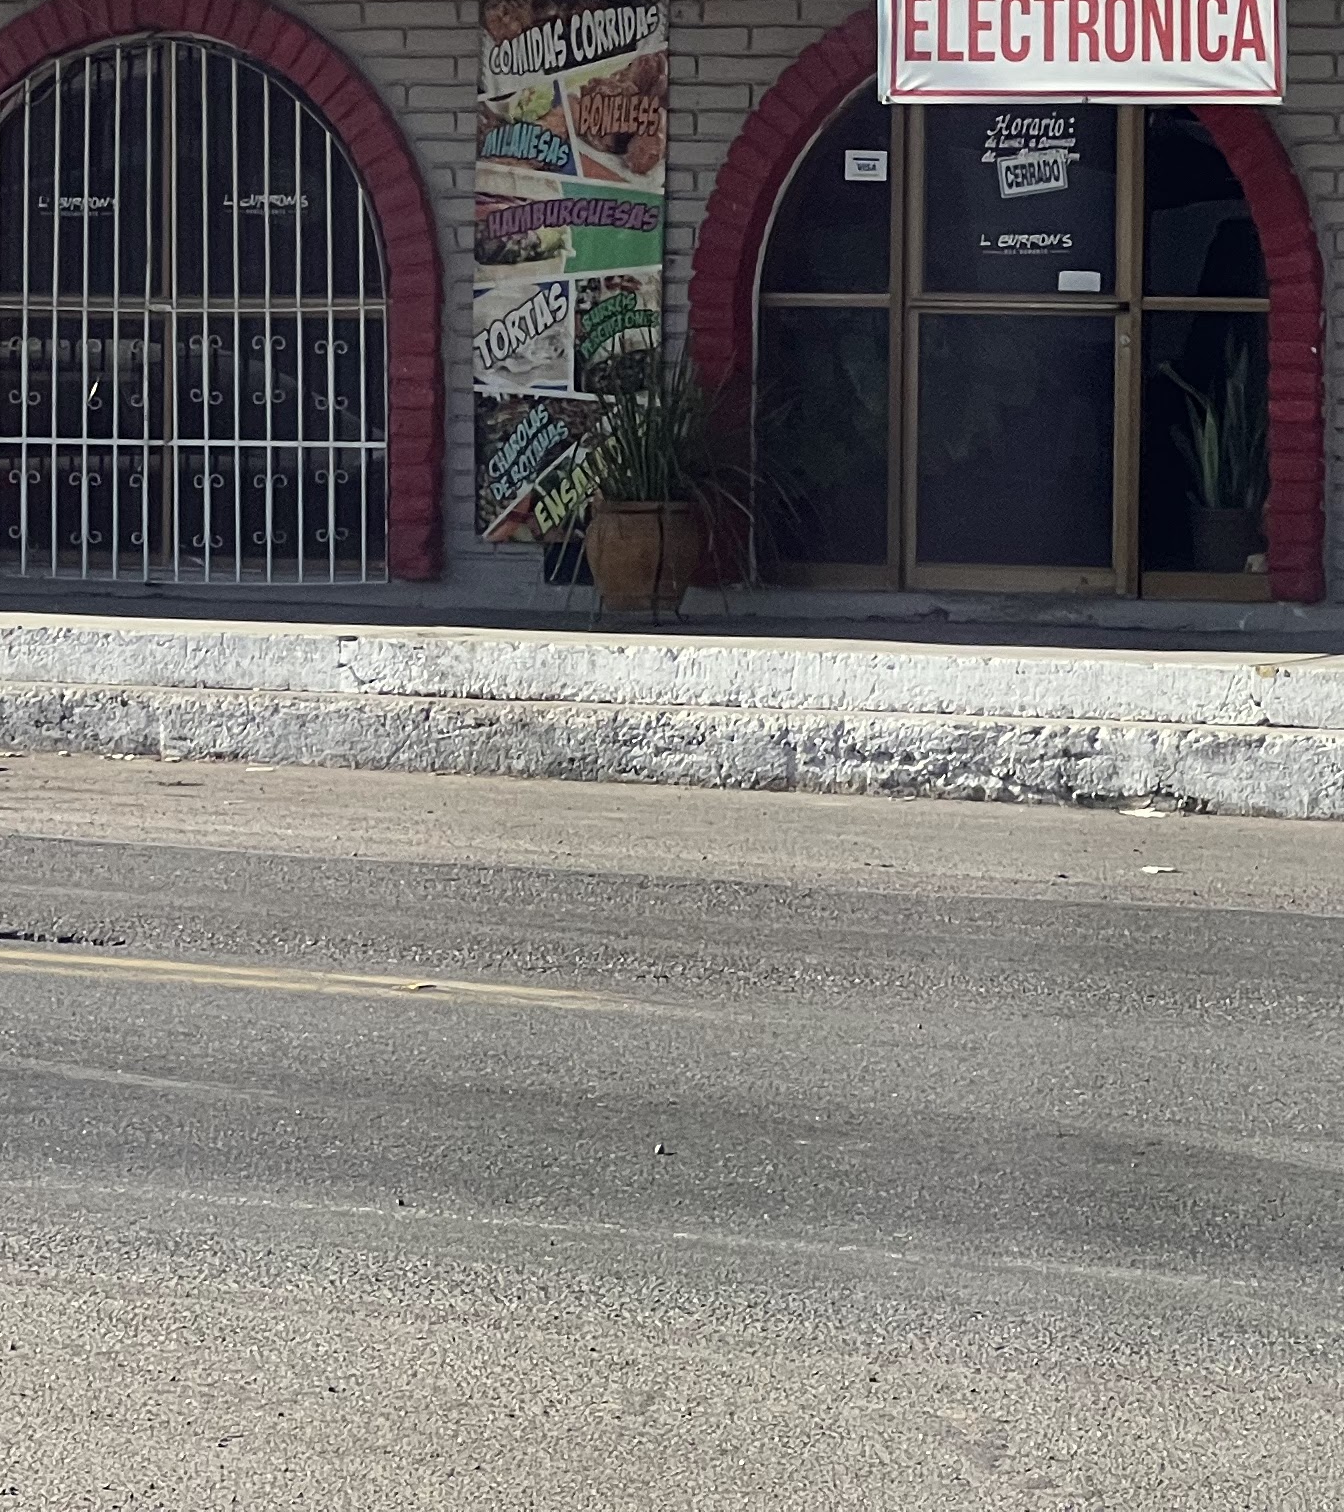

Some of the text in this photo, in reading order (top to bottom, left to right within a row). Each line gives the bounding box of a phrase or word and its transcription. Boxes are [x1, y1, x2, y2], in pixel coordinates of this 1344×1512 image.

[488, 4, 659, 76] COMIDAS CORRIDAS
[578, 93, 661, 138] BONELESS
[1004, 159, 1061, 190] CERRADO
[487, 197, 660, 240] HAMBURGUESAS
[474, 282, 570, 369] TORTAS
